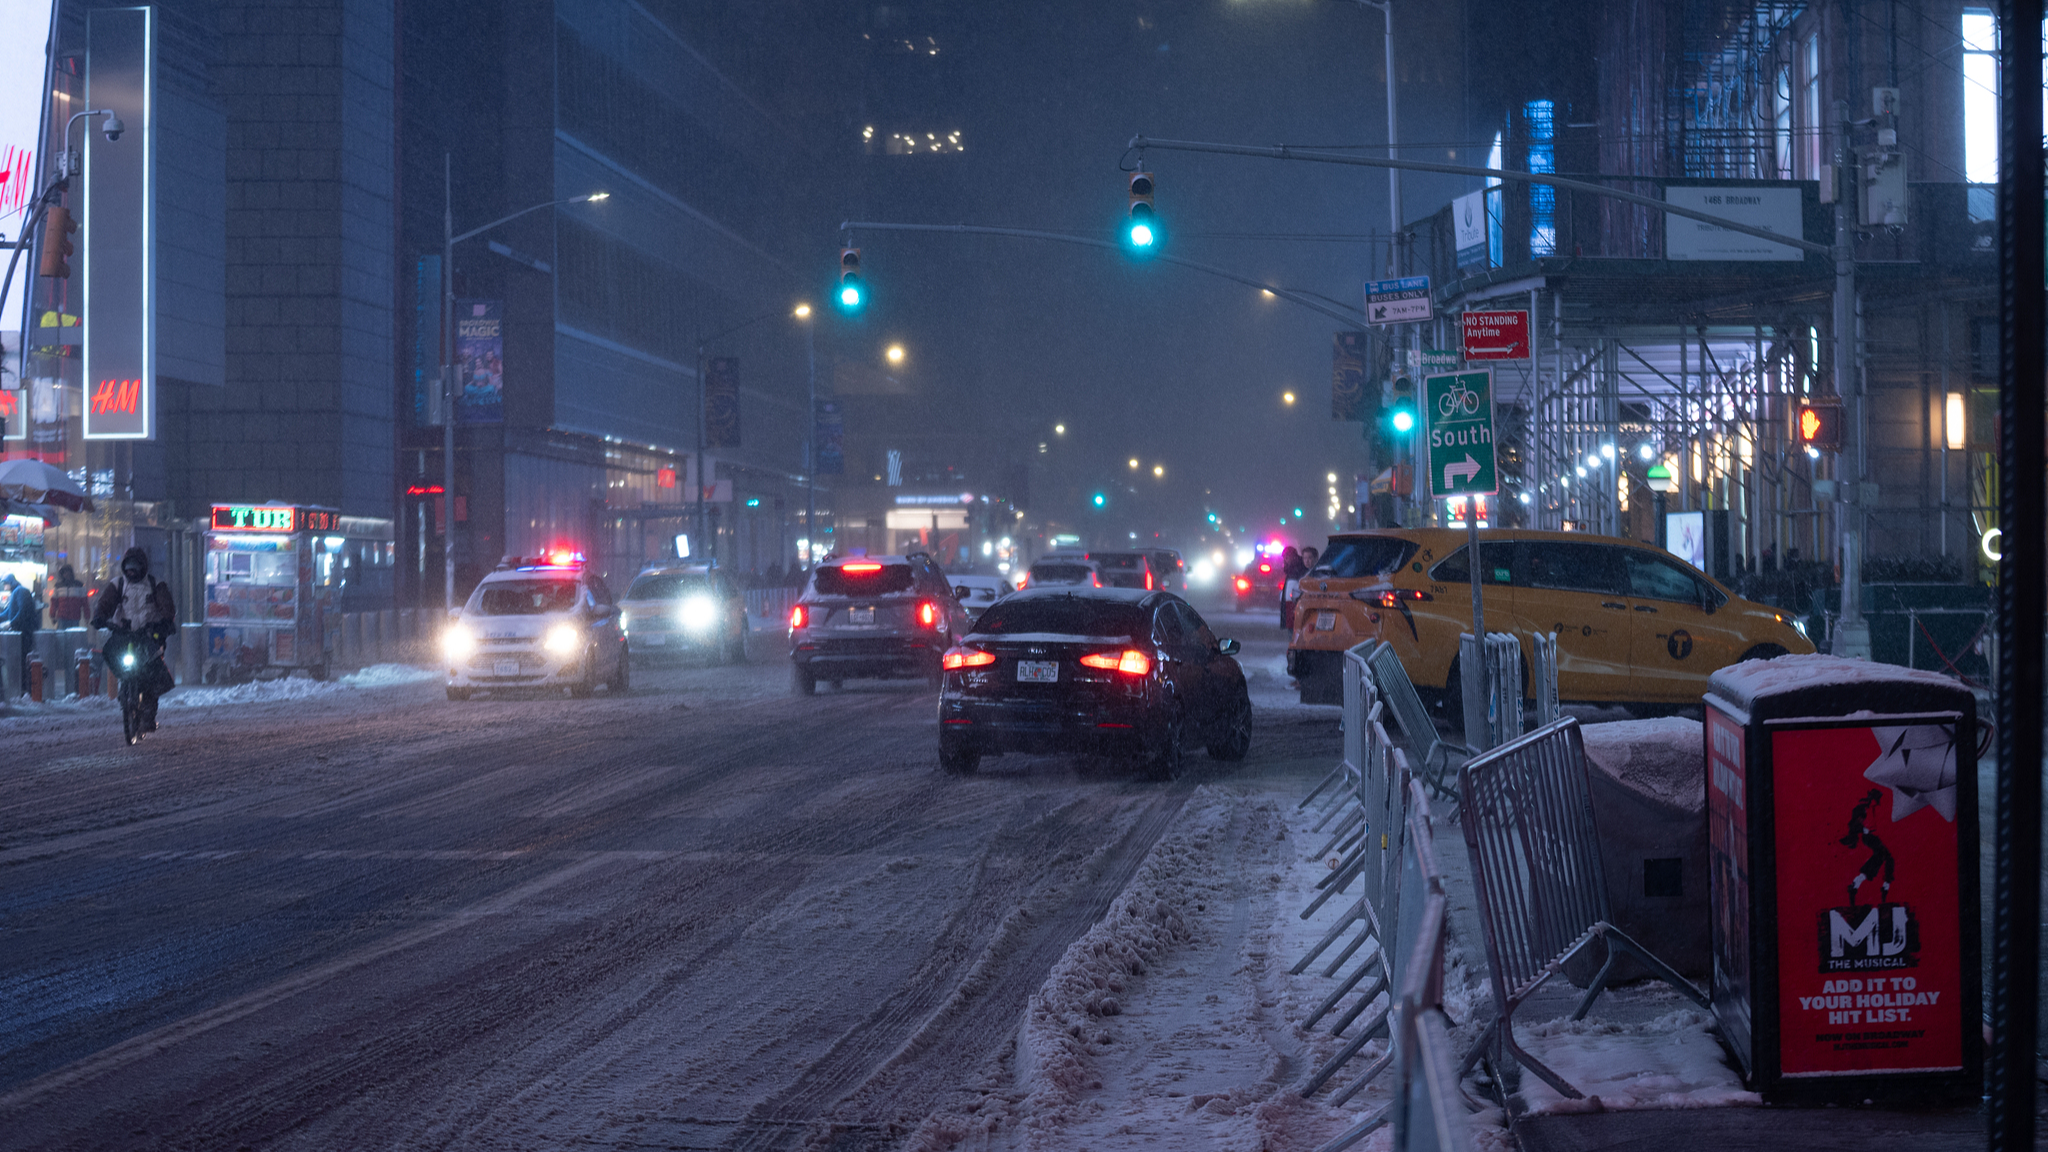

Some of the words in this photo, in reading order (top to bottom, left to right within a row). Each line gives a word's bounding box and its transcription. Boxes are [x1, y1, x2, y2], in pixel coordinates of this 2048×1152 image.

[1725, 196, 1762, 206] BROADWAY
[1460, 226, 1480, 243] Tribute
[1382, 281, 1400, 291] BUS
[1402, 279, 1425, 289] LANE
[1371, 292, 1400, 302] BUSES
[1402, 290, 1425, 299] ONLY
[1466, 316, 1478, 326] NO
[1479, 315, 1518, 326] STANDING
[459, 326, 500, 338] MAGIC
[1467, 327, 1500, 339] Anytime
[1422, 353, 1457, 365] Broadwa
[91, 379, 141, 415] H&M
[1432, 423, 1491, 448] South
[1829, 906, 1908, 957] MJ
[1828, 959, 1851, 969] THE
[1854, 957, 1907, 968] MUSICAL
[1822, 979, 1863, 994] ADD
[1867, 978, 1886, 992] IT
[1890, 976, 1917, 991] TO
[1799, 995, 1852, 1011] YOUR
[1856, 991, 1940, 1008] HOLIDAY
[1828, 1009, 1862, 1025] HIT
[1866, 1008, 1912, 1023] LIST.
[1815, 1033, 1843, 1042] NOW
[1845, 1032, 1861, 1041] ON
[1863, 1029, 1926, 1040] BROADWAY
